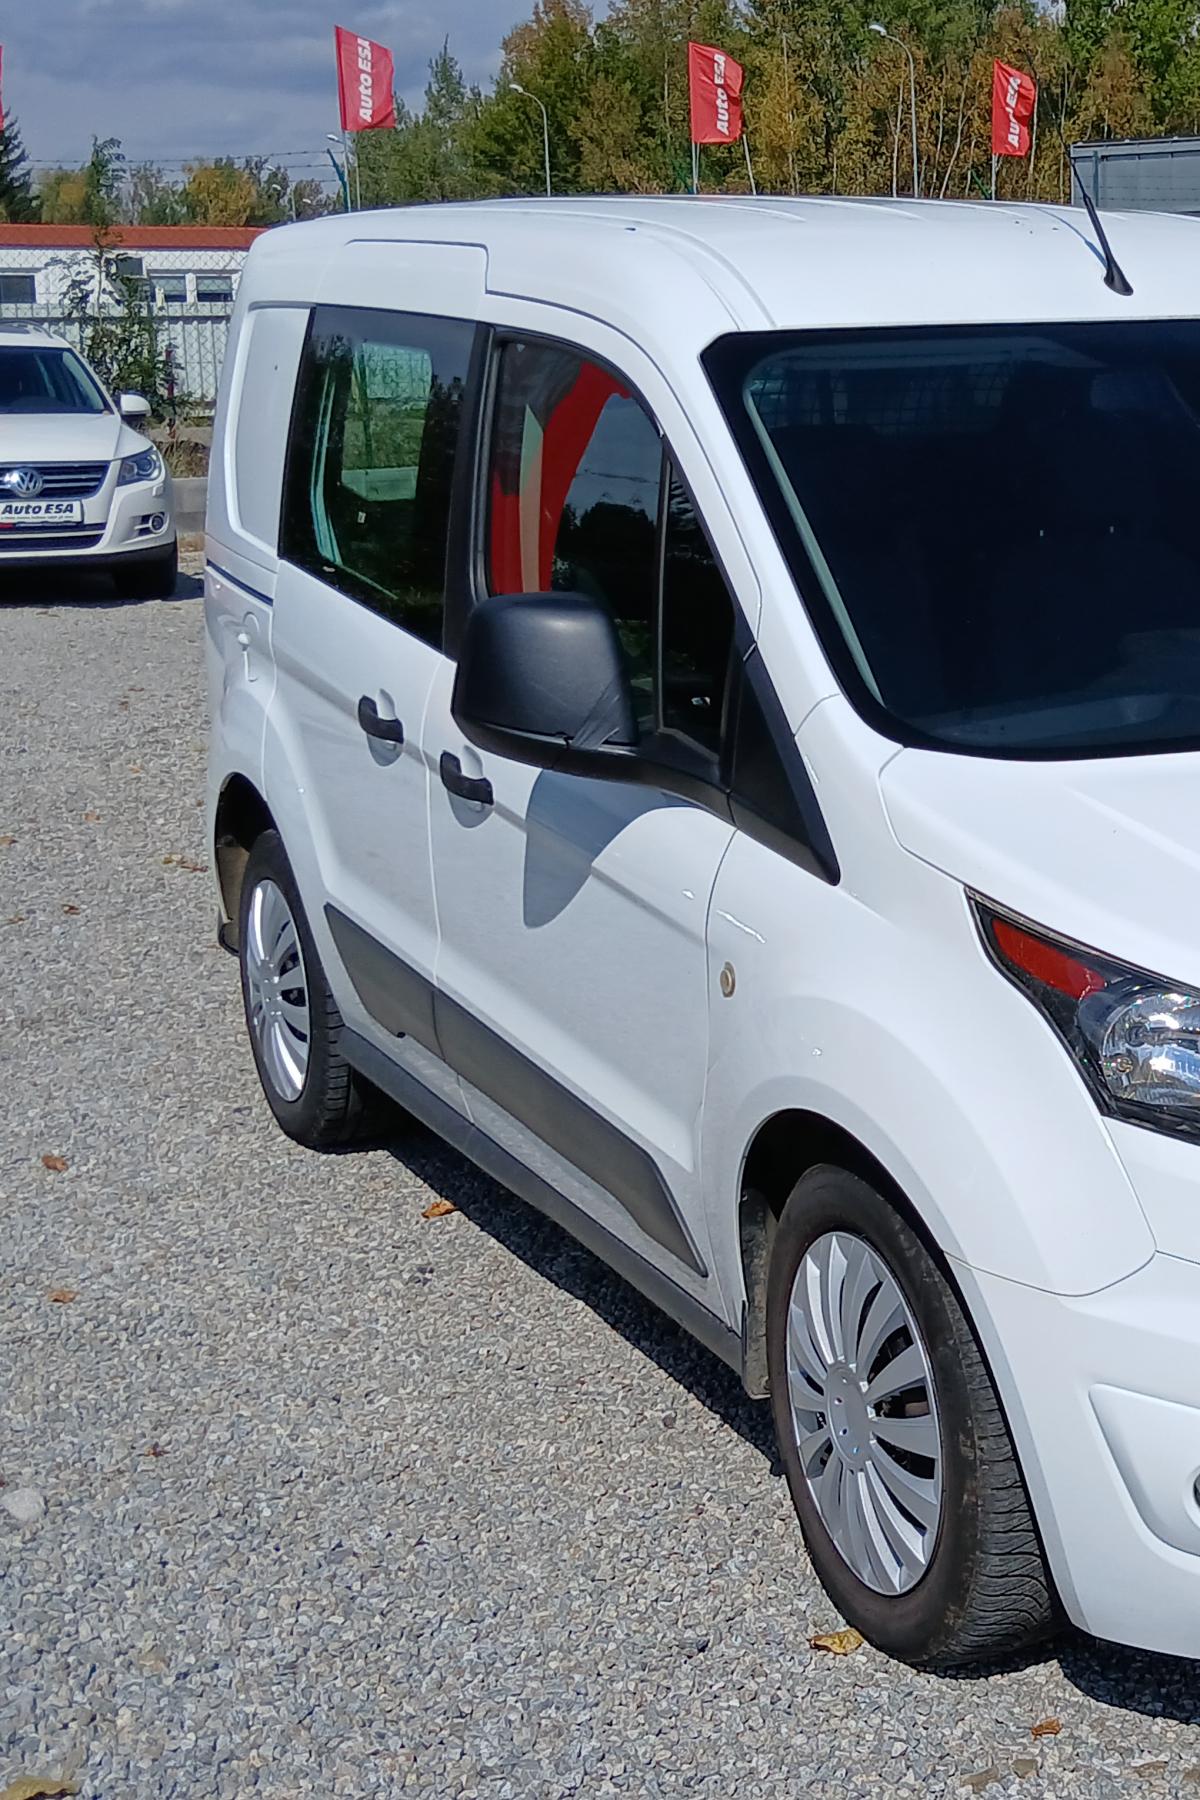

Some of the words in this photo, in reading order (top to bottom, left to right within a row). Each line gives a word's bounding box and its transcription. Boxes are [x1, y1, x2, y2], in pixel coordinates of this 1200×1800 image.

[357, 37, 372, 72] ESA
[358, 73, 373, 122] Auto
[715, 87, 729, 136] Auto
[1, 504, 42, 514] Auto
[44, 503, 74, 514] ESA
